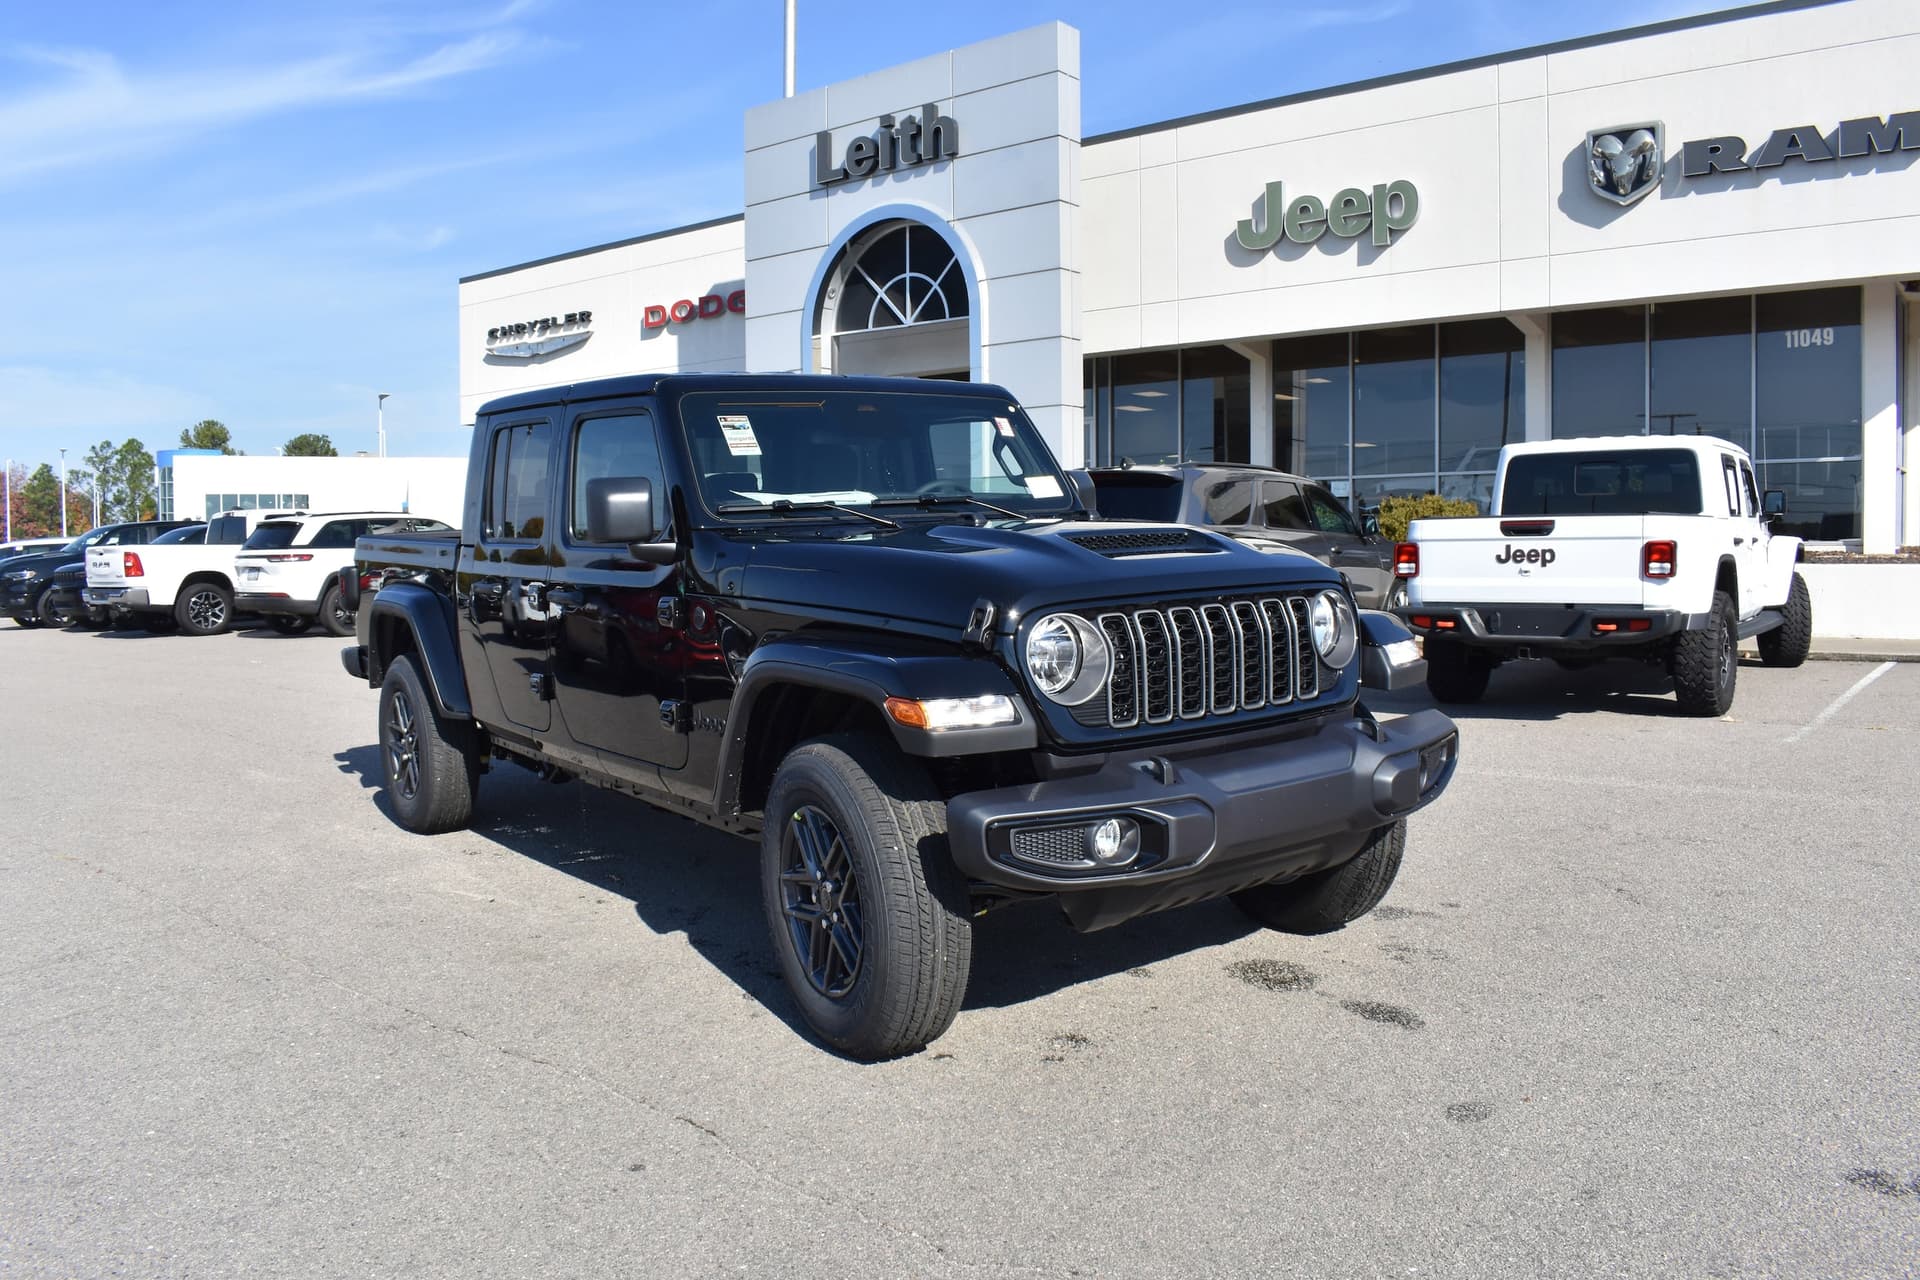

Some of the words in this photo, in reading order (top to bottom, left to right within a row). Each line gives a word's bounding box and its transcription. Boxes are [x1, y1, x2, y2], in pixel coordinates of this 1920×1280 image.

[816, 102, 959, 185] Leith
[1682, 110, 1920, 177] RAM
[1236, 179, 1419, 250] Jeep
[487, 310, 592, 339] CHRYSLER
[644, 289, 745, 329] DODG
[1785, 327, 1834, 349] 11049
[1495, 544, 1556, 568] Jeep
